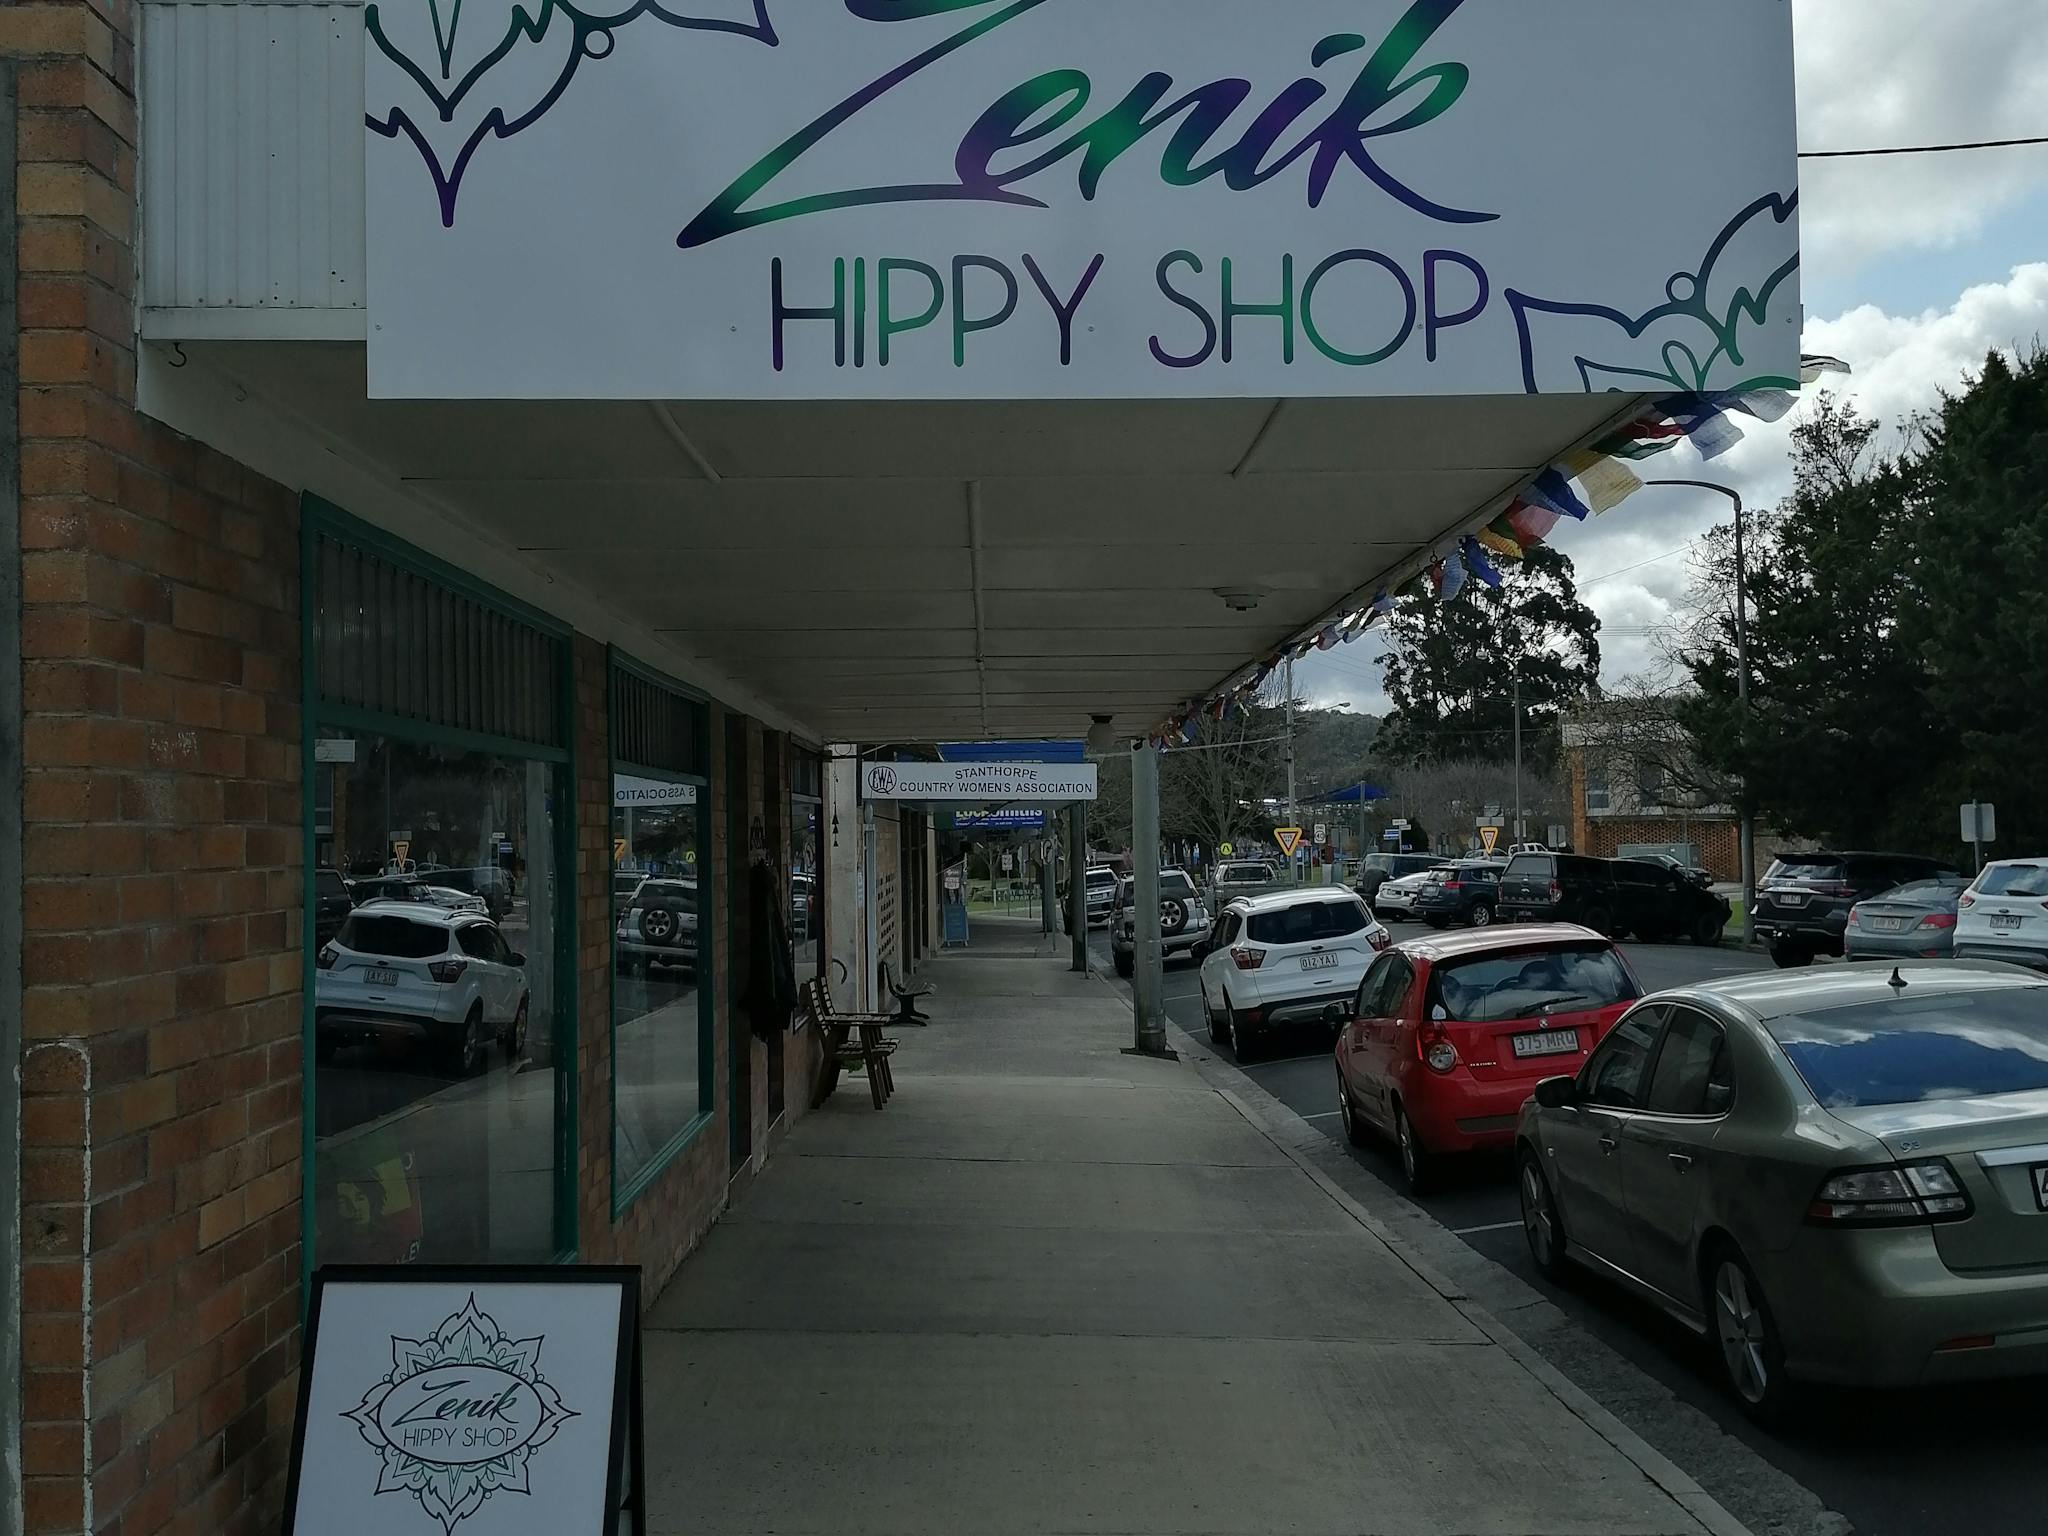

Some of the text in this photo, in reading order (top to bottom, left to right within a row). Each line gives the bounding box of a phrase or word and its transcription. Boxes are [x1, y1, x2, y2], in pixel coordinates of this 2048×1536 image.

[676, 0, 1501, 248] Zenik
[771, 248, 1490, 372] HIPPY SHOP
[900, 781, 1093, 793] COUNTRY WOMEN'S ASSOCIATION
[955, 766, 1038, 780] STANTHORPE
[391, 1379, 523, 1427] Zenik
[403, 1427, 517, 1447] HIPPY SHOP
